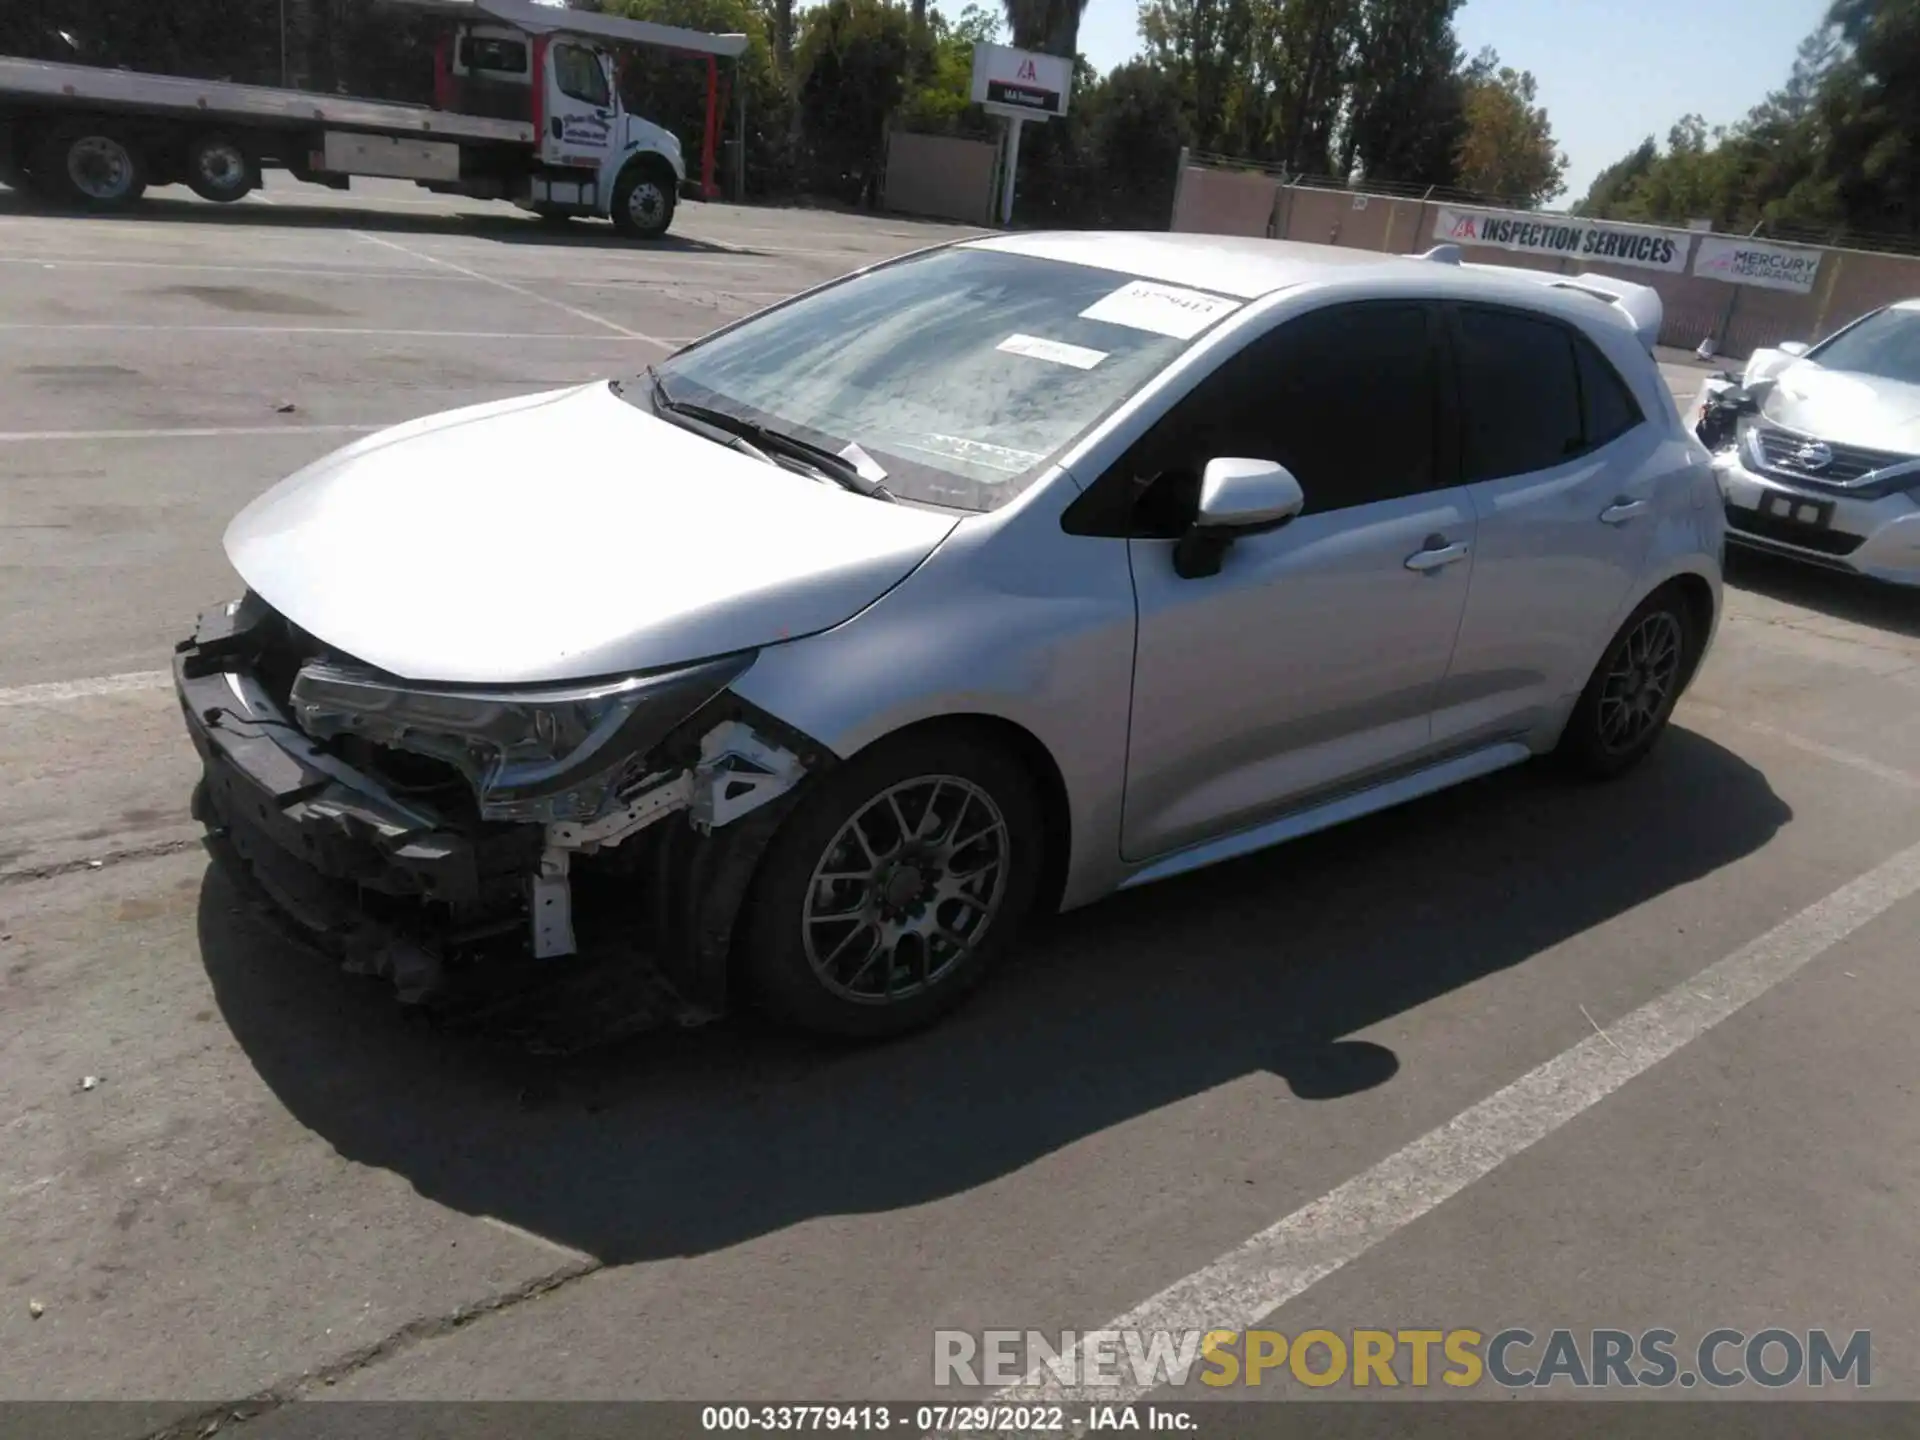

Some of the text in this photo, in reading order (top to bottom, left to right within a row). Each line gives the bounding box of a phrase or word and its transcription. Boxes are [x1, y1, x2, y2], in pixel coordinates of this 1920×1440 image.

[1481, 218, 1582, 252] INSPECTION
[1582, 229, 1674, 264] SERVICES
[1733, 250, 1817, 272] MERCURY
[1730, 264, 1814, 285] INSURANCE
